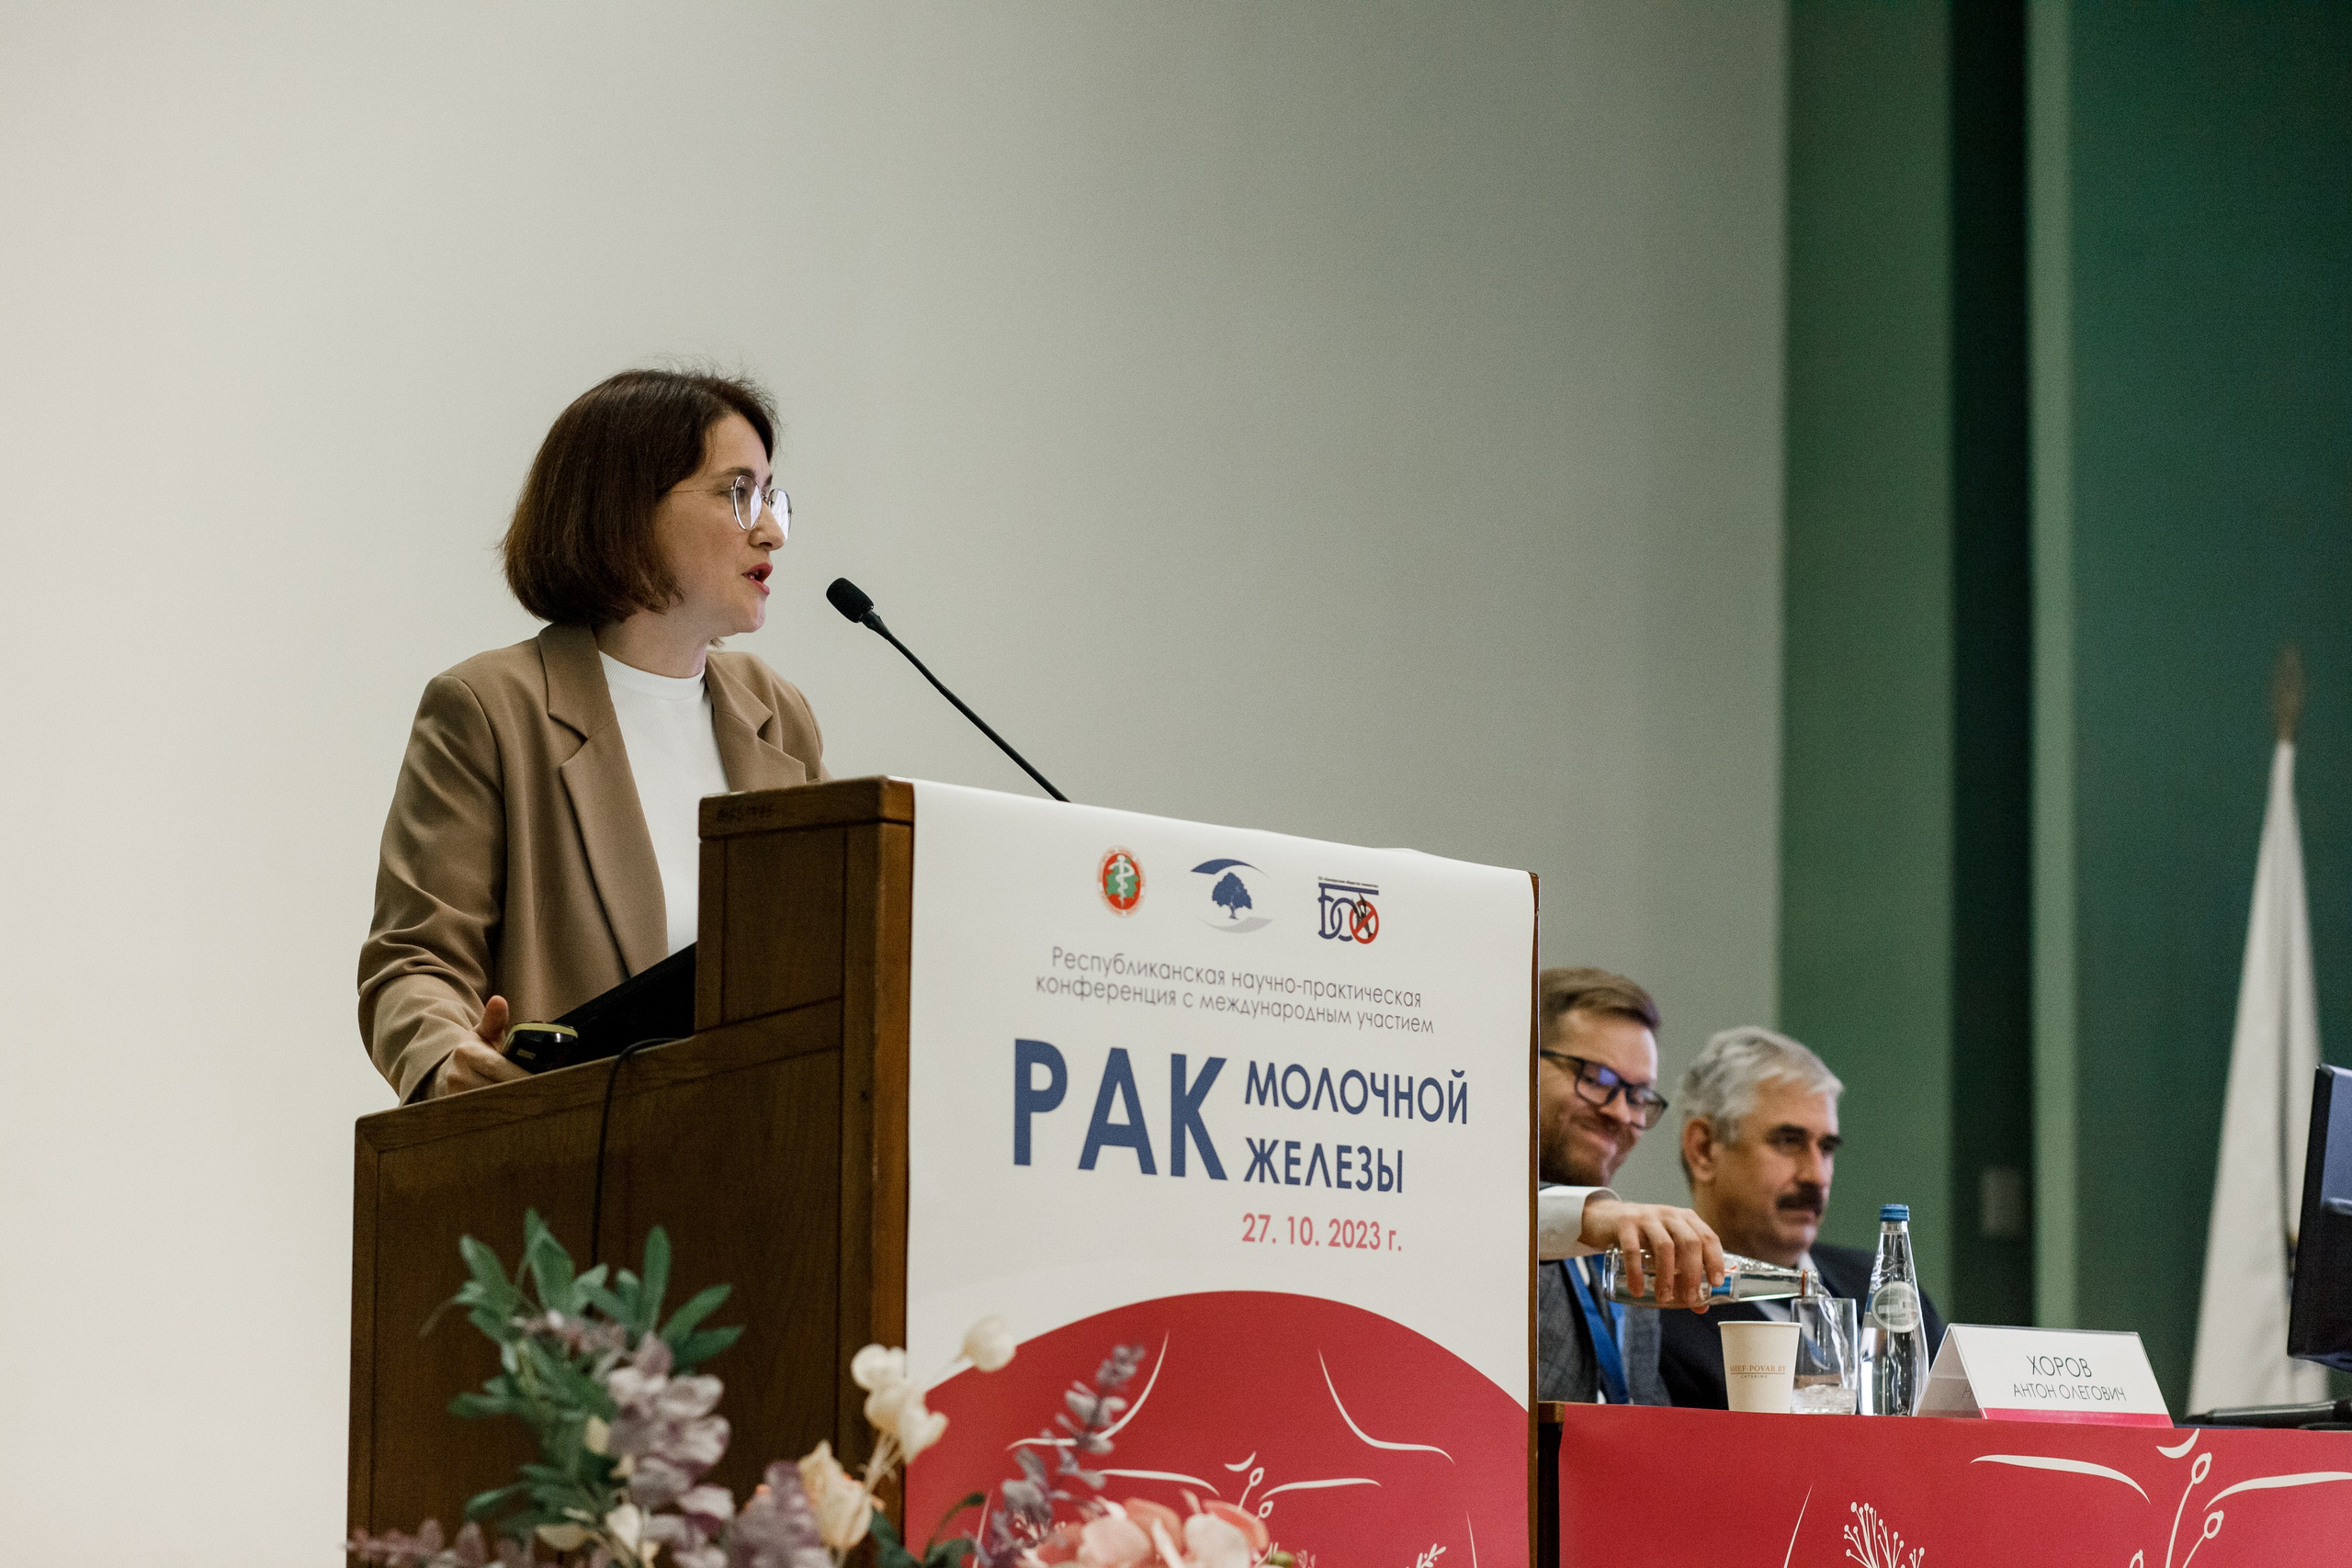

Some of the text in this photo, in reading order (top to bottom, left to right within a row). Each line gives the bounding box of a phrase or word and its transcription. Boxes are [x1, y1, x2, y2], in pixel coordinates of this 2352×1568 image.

[1036, 976, 1433, 1032] конференция с международным участием
[1053, 946, 1420, 1007] Республиканская научно-практическая
[1013, 1039, 1227, 1180] РАК
[1245, 1061, 1467, 1124] МОЛОЧНОЙ
[1244, 1137, 1402, 1193] ЖЕЛЕЗЫ
[1329, 1218, 1380, 1250] 2023
[1388, 1230, 1401, 1251] г.
[2014, 1383, 2126, 1401] АНТОН ОЛЕГОВИЧ
[2027, 1356, 2092, 1378] ХОРОВ
